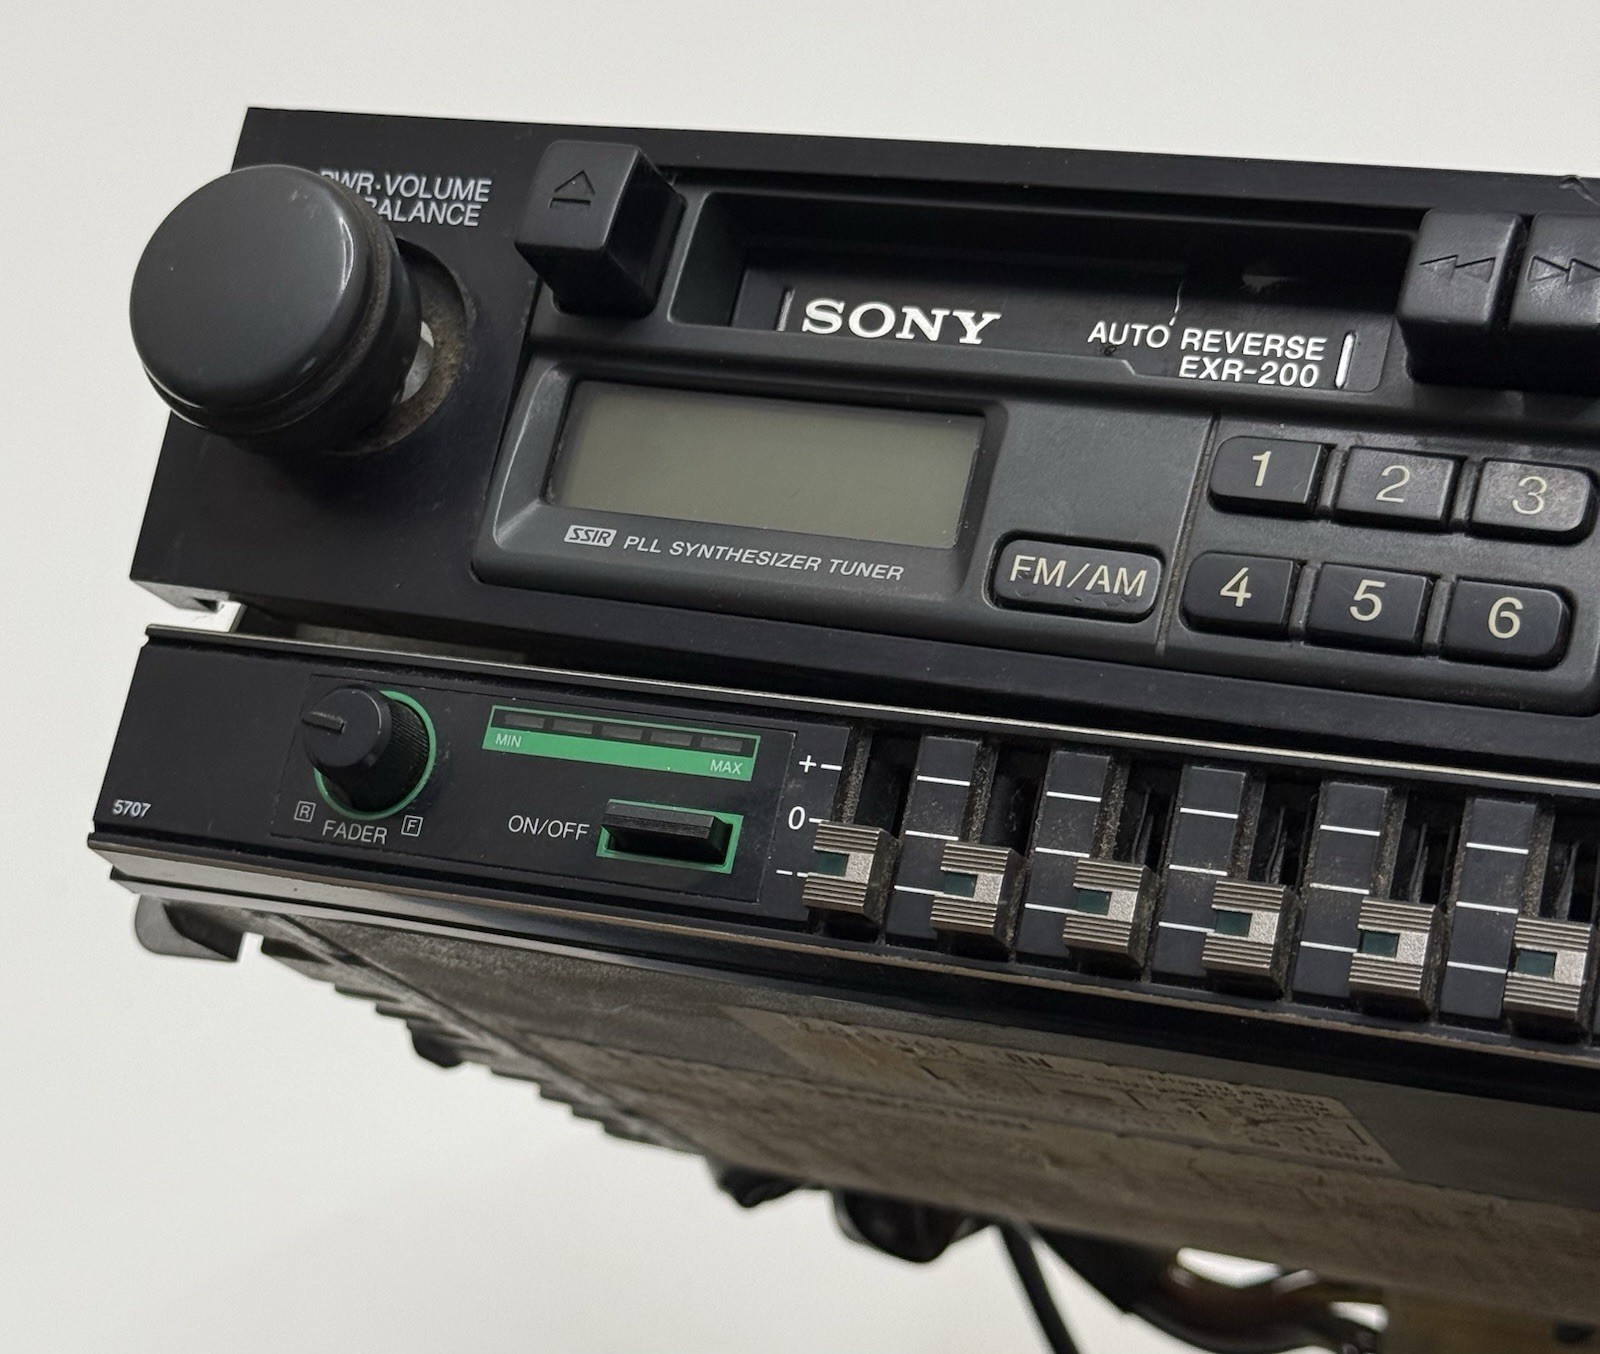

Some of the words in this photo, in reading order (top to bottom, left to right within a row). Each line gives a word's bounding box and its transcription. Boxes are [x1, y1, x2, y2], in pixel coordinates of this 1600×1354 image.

[801, 298, 1002, 345] SONY
[1087, 321, 1171, 349] AUTO
[1179, 327, 1327, 362] REVERSE
[1178, 356, 1319, 388] EXR-200
[1251, 450, 1272, 487] 1
[1375, 464, 1410, 503] 2
[1511, 475, 1547, 515] 3
[623, 535, 662, 554] PLL
[669, 541, 822, 572] SYNTHESIZER
[829, 558, 905, 582] TUNER
[1009, 554, 1148, 597] FM/AM
[1219, 567, 1252, 607] 4
[1348, 579, 1386, 622] 5
[1487, 596, 1524, 639] 6
[495, 733, 522, 748] MIN
[709, 759, 743, 775] MAX
[112, 799, 152, 818] 5707
[508, 814, 590, 841] ON/OFF
[322, 820, 388, 844] FADER
